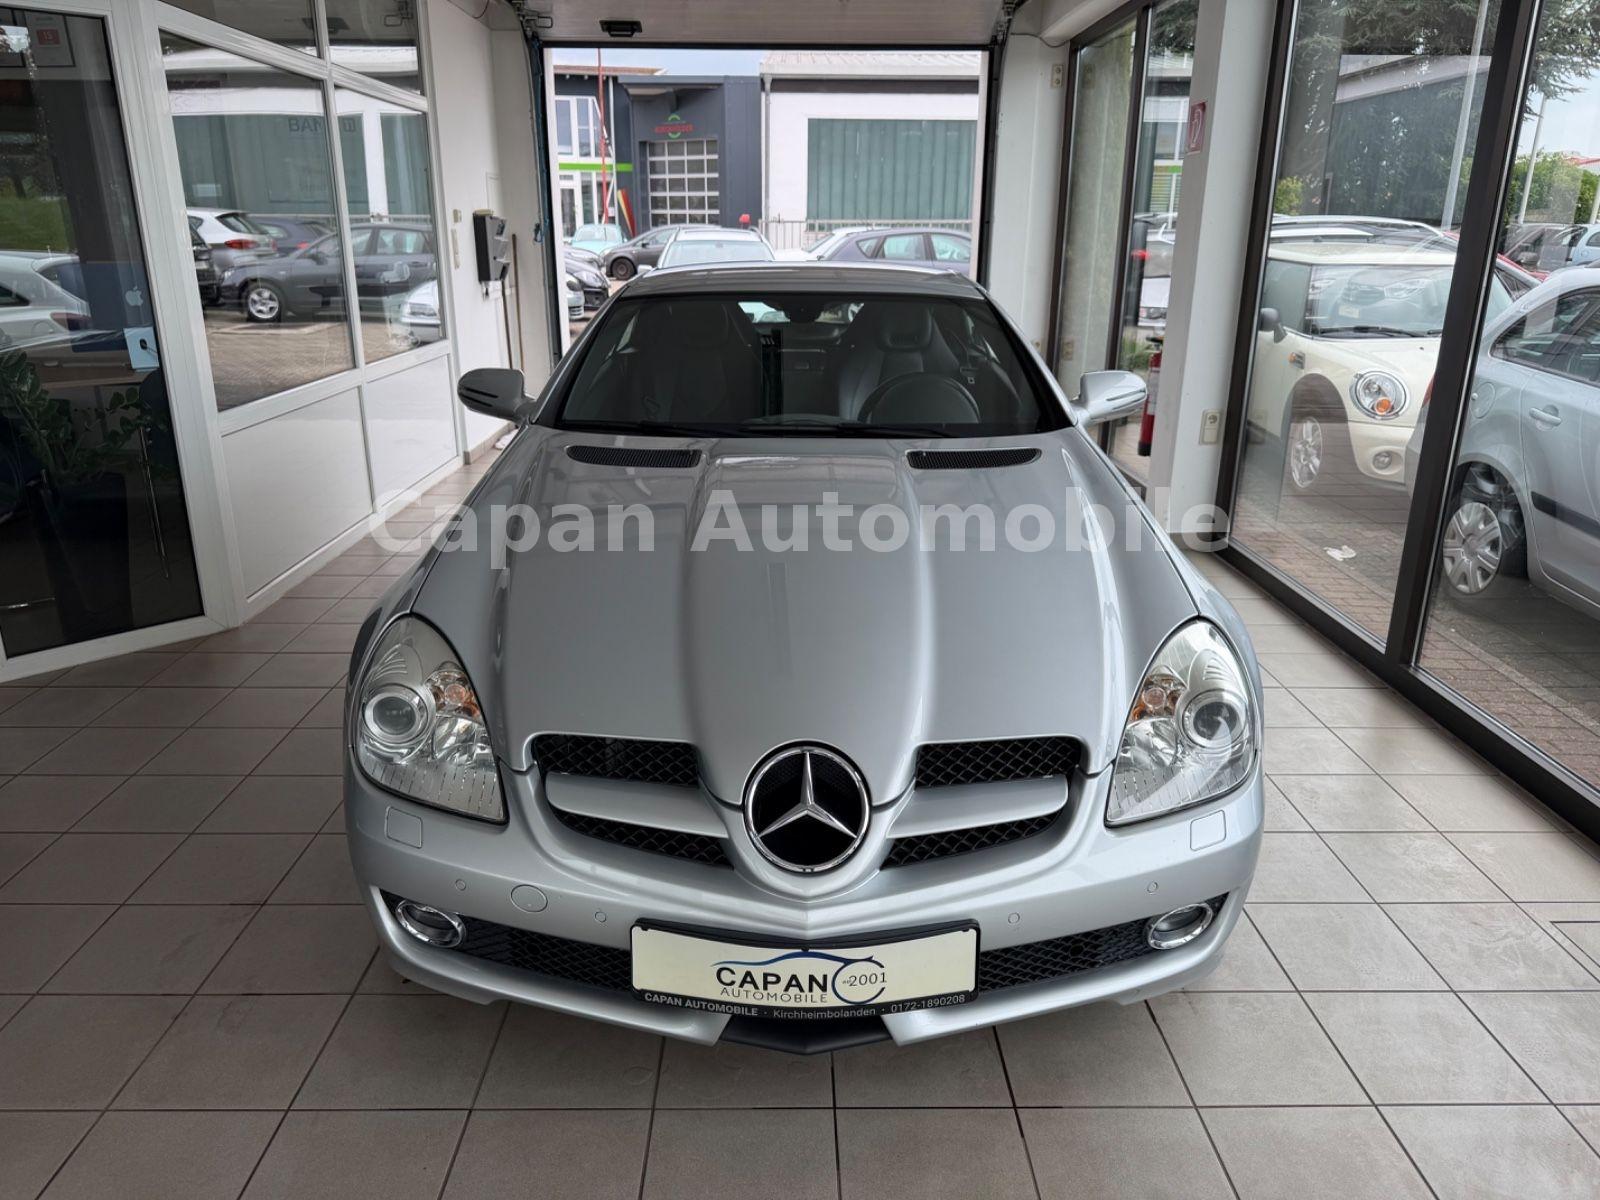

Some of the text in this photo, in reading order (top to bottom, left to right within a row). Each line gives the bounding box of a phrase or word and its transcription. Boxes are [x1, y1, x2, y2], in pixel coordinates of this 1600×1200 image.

[716, 966, 828, 993] CAPAN
[848, 971, 887, 987] 2001
[644, 991, 965, 1020] CAPAN AUTOMOBILE Kirchheimbolanden 0172-1890208
[720, 987, 828, 1003] AUTOMOBILE
